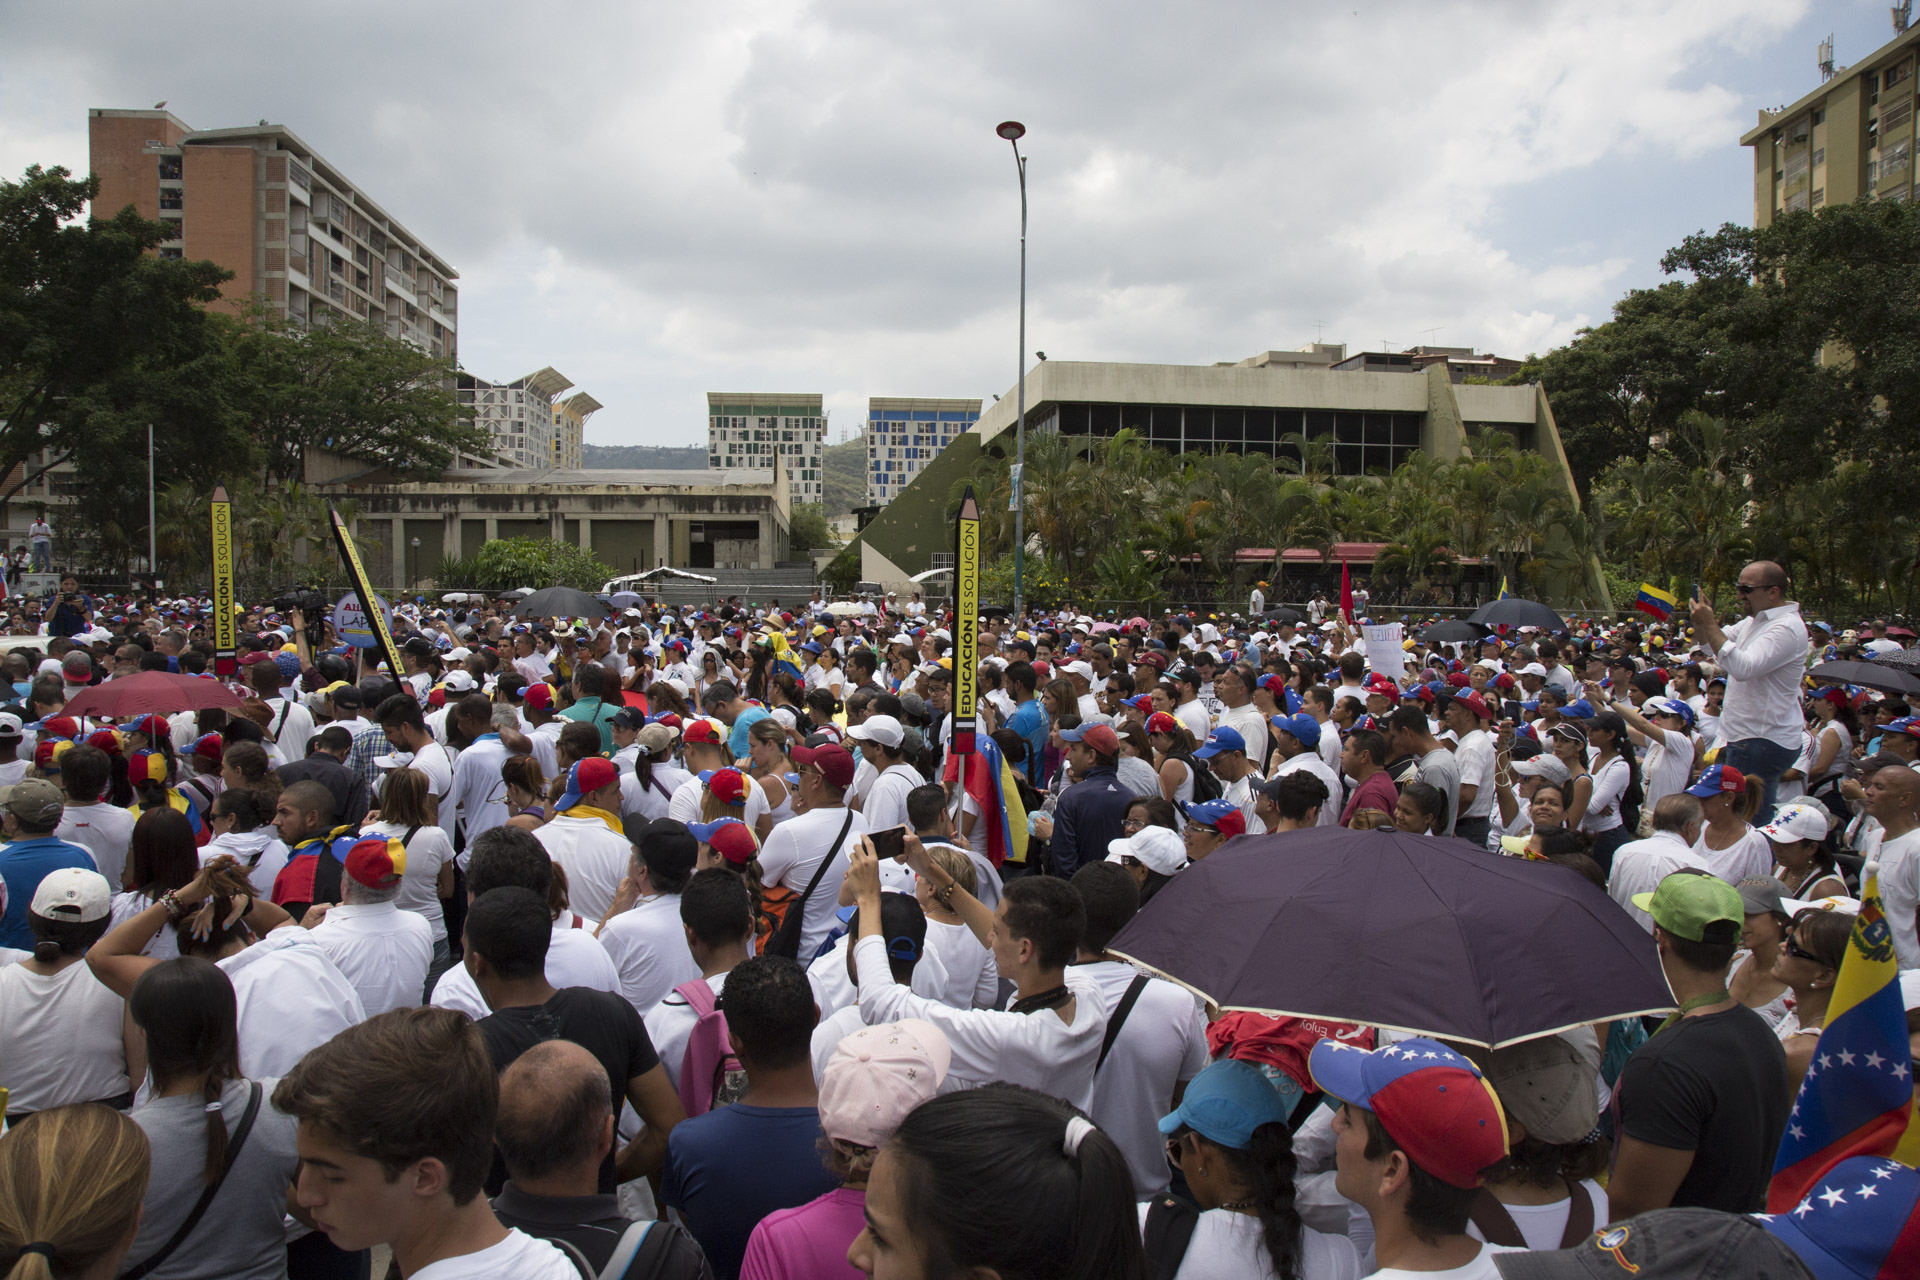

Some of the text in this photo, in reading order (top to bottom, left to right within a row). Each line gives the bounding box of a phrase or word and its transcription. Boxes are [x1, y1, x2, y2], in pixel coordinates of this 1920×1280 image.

[214, 504, 230, 647] EDUCACIÓN ES SOLUCIÓN
[961, 523, 975, 715] EDUCACIÓN ES SOLUCIÓN
[1300, 1020, 1327, 1036] Enjoy
